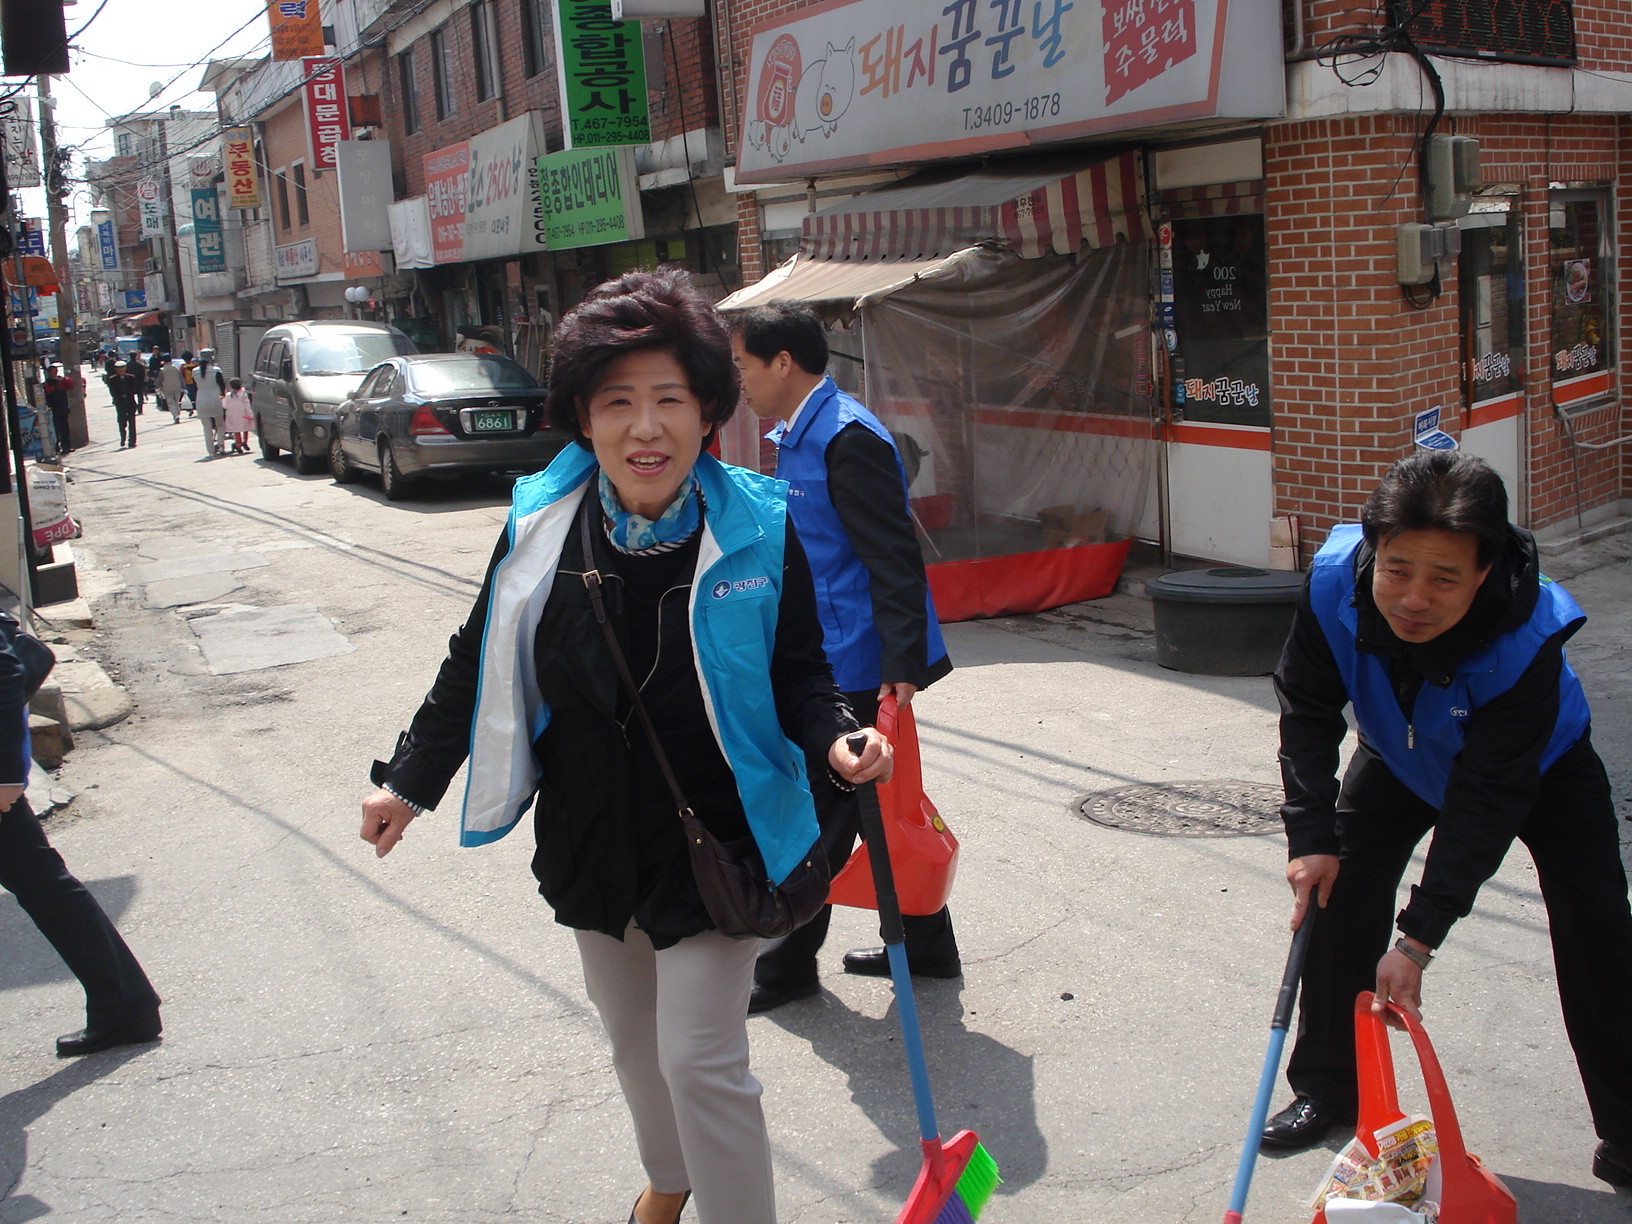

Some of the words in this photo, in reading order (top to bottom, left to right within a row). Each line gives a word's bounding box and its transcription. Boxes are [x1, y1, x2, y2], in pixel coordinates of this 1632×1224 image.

[571, 115, 648, 131] T.467-7954
[962, 92, 1061, 131] T.3409-1878
[228, 142, 254, 195] 부동산
[550, 150, 621, 214] 종합인테리어
[194, 197, 221, 256] 여관
[1185, 377, 1259, 407] 돼지꿈꾼날
[477, 416, 508, 429] 6861
[733, 577, 768, 591] 광진구
